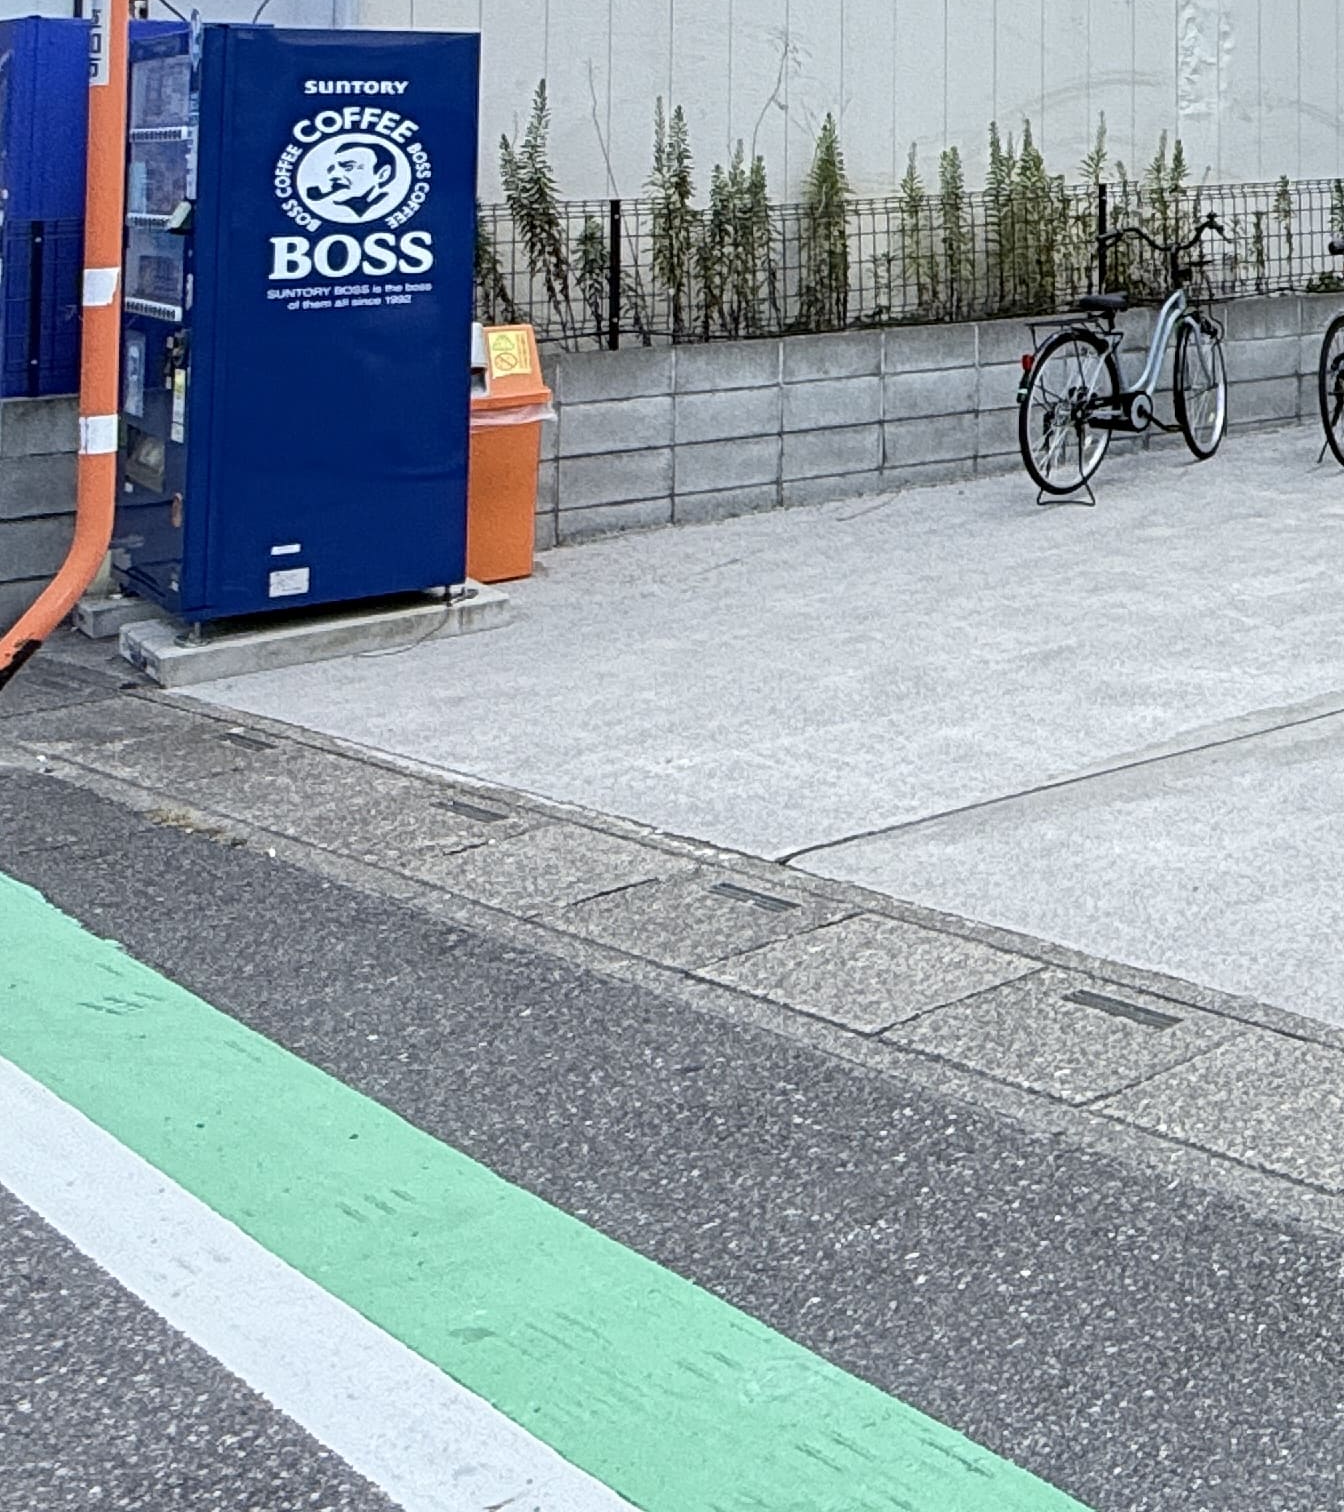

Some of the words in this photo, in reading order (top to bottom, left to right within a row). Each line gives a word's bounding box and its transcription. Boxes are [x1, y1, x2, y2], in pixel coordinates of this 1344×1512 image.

[293, 106, 419, 144] COFFEE
[274, 144, 303, 198] COFFEE
[407, 142, 432, 179] BOSS
[282, 199, 322, 233] BOSS
[385, 182, 430, 230] COFFEE
[268, 231, 434, 280] BOSS
[266, 286, 332, 300] SUNTORY
[334, 284, 370, 296] BOSS
